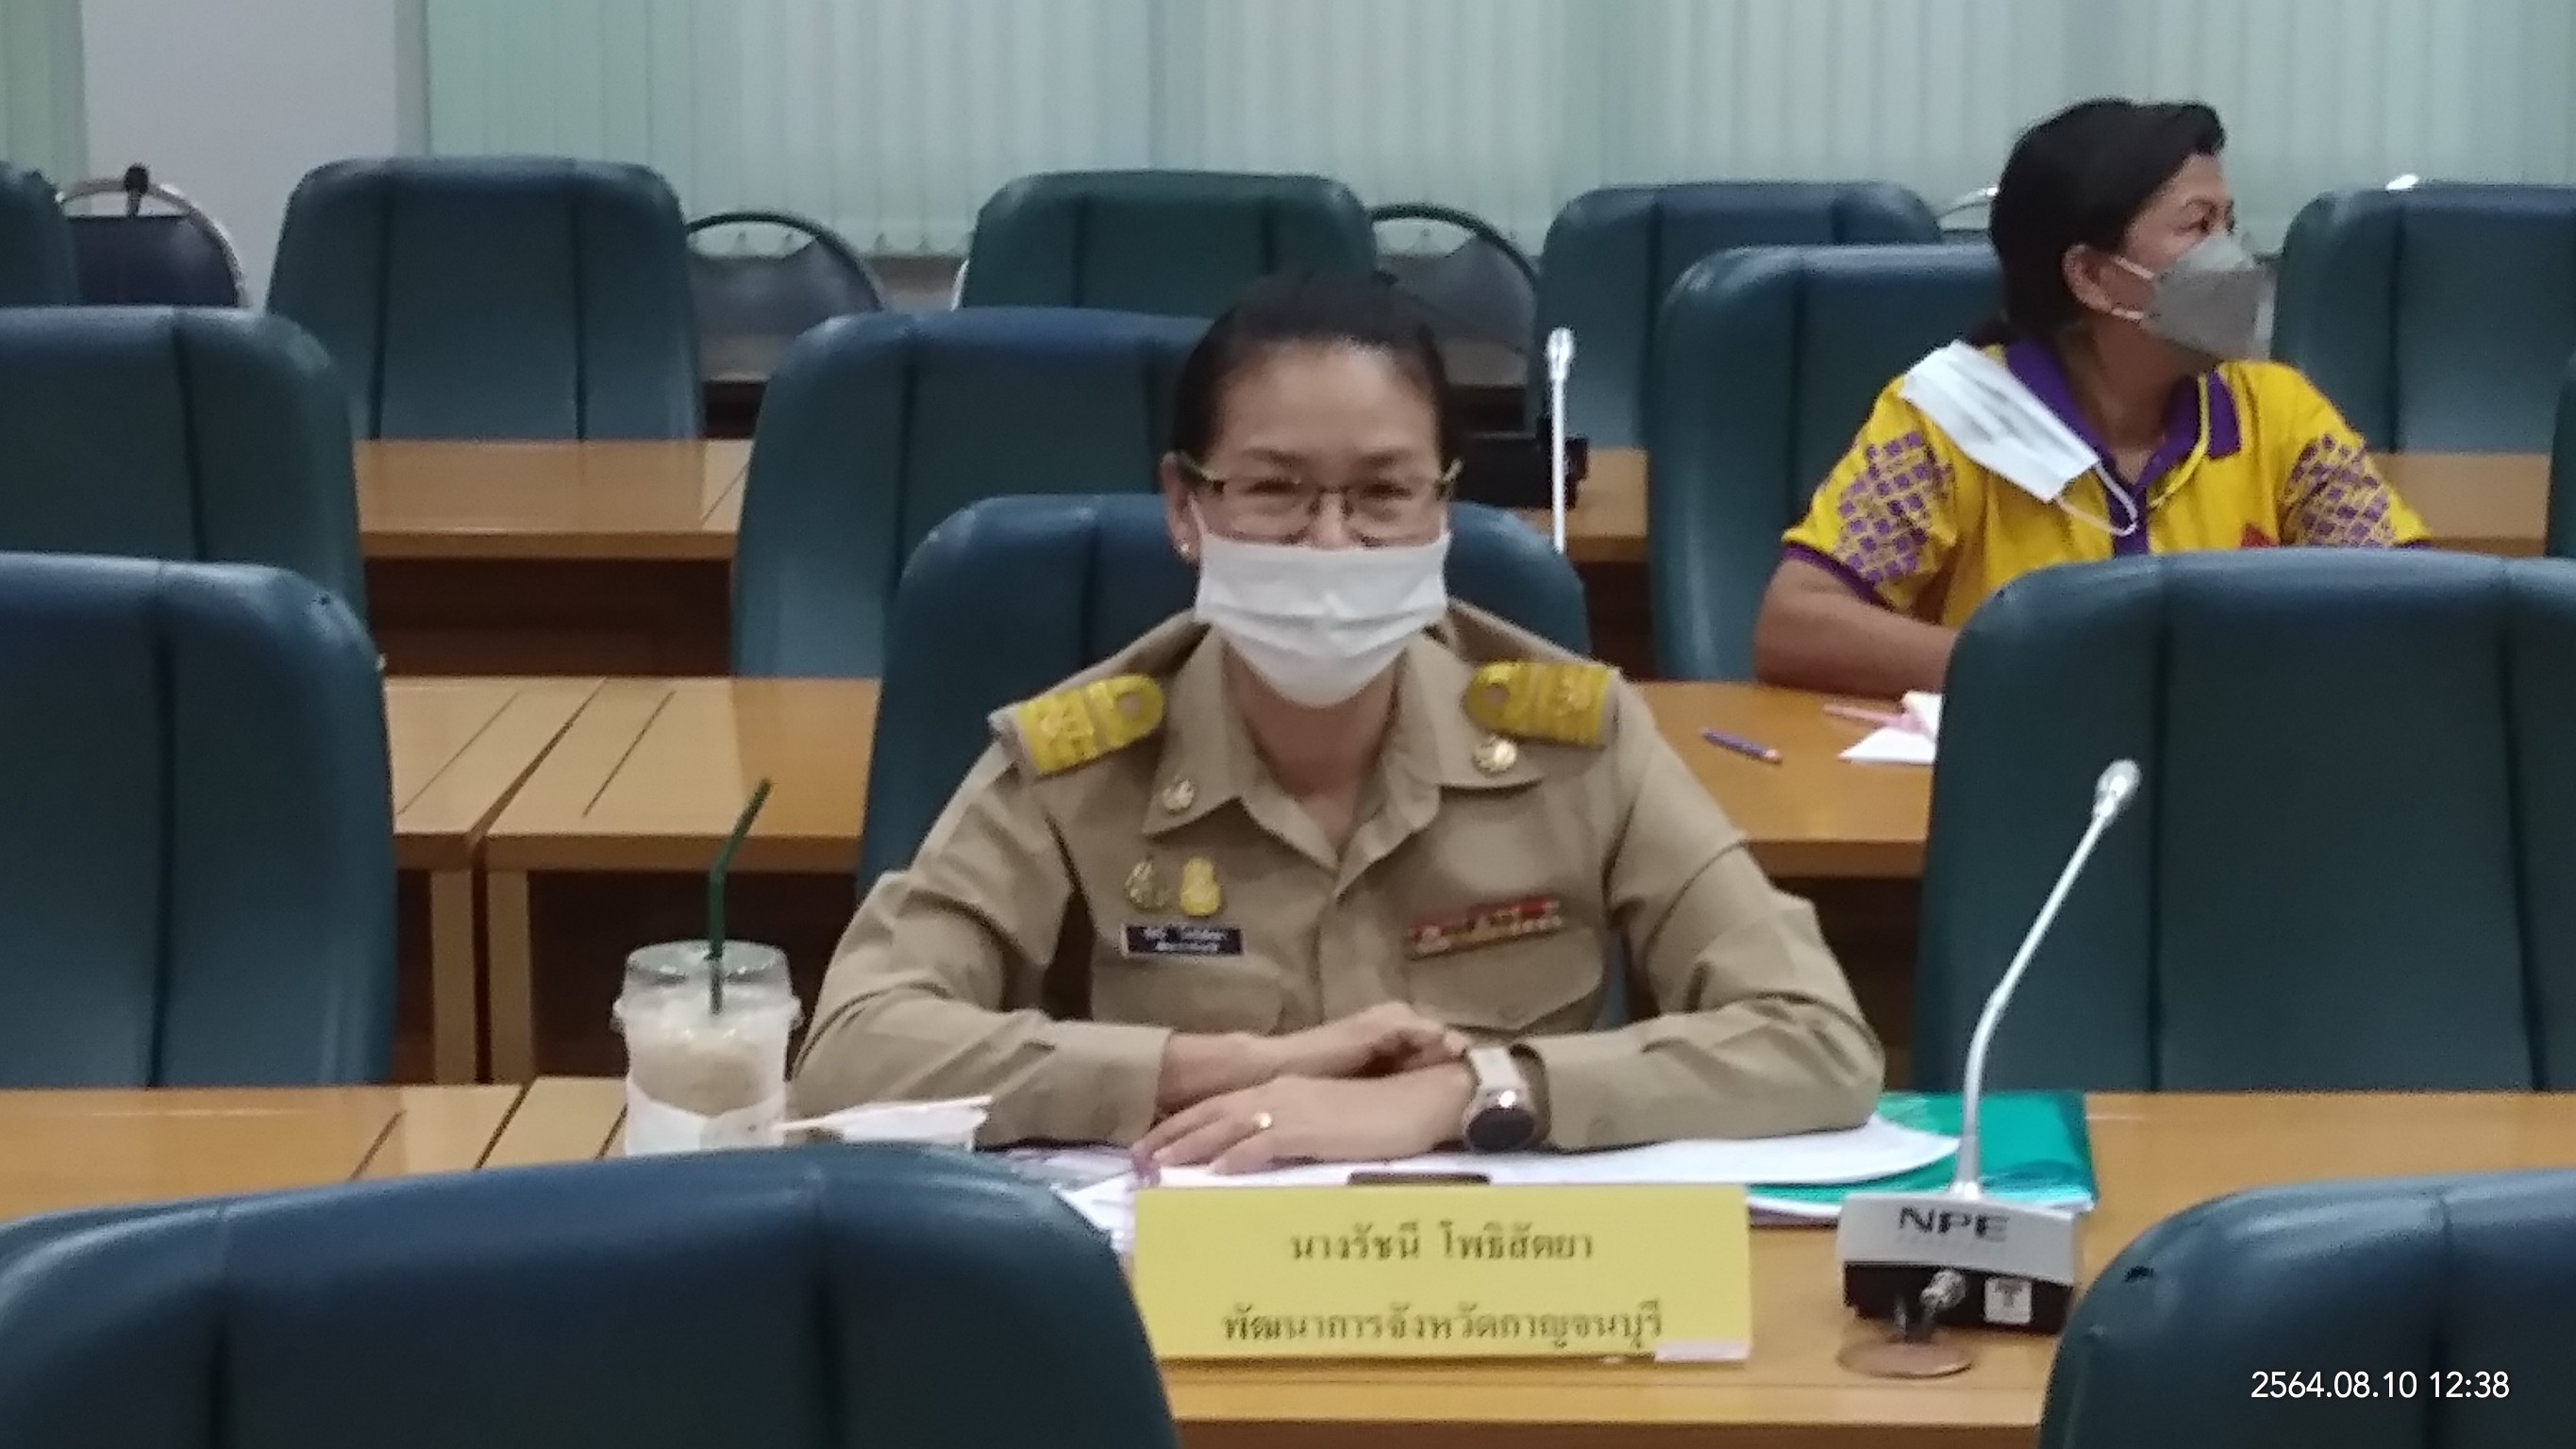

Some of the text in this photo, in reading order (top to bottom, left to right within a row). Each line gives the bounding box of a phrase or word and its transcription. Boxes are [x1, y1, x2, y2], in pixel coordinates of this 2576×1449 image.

[1291, 1220, 1593, 1259] นางรัชนี โพธิสัตยา
[1899, 1207, 2010, 1242] NPE
[1224, 1298, 1663, 1350] พัฒนาการจังหวัดกาญจนบุรี
